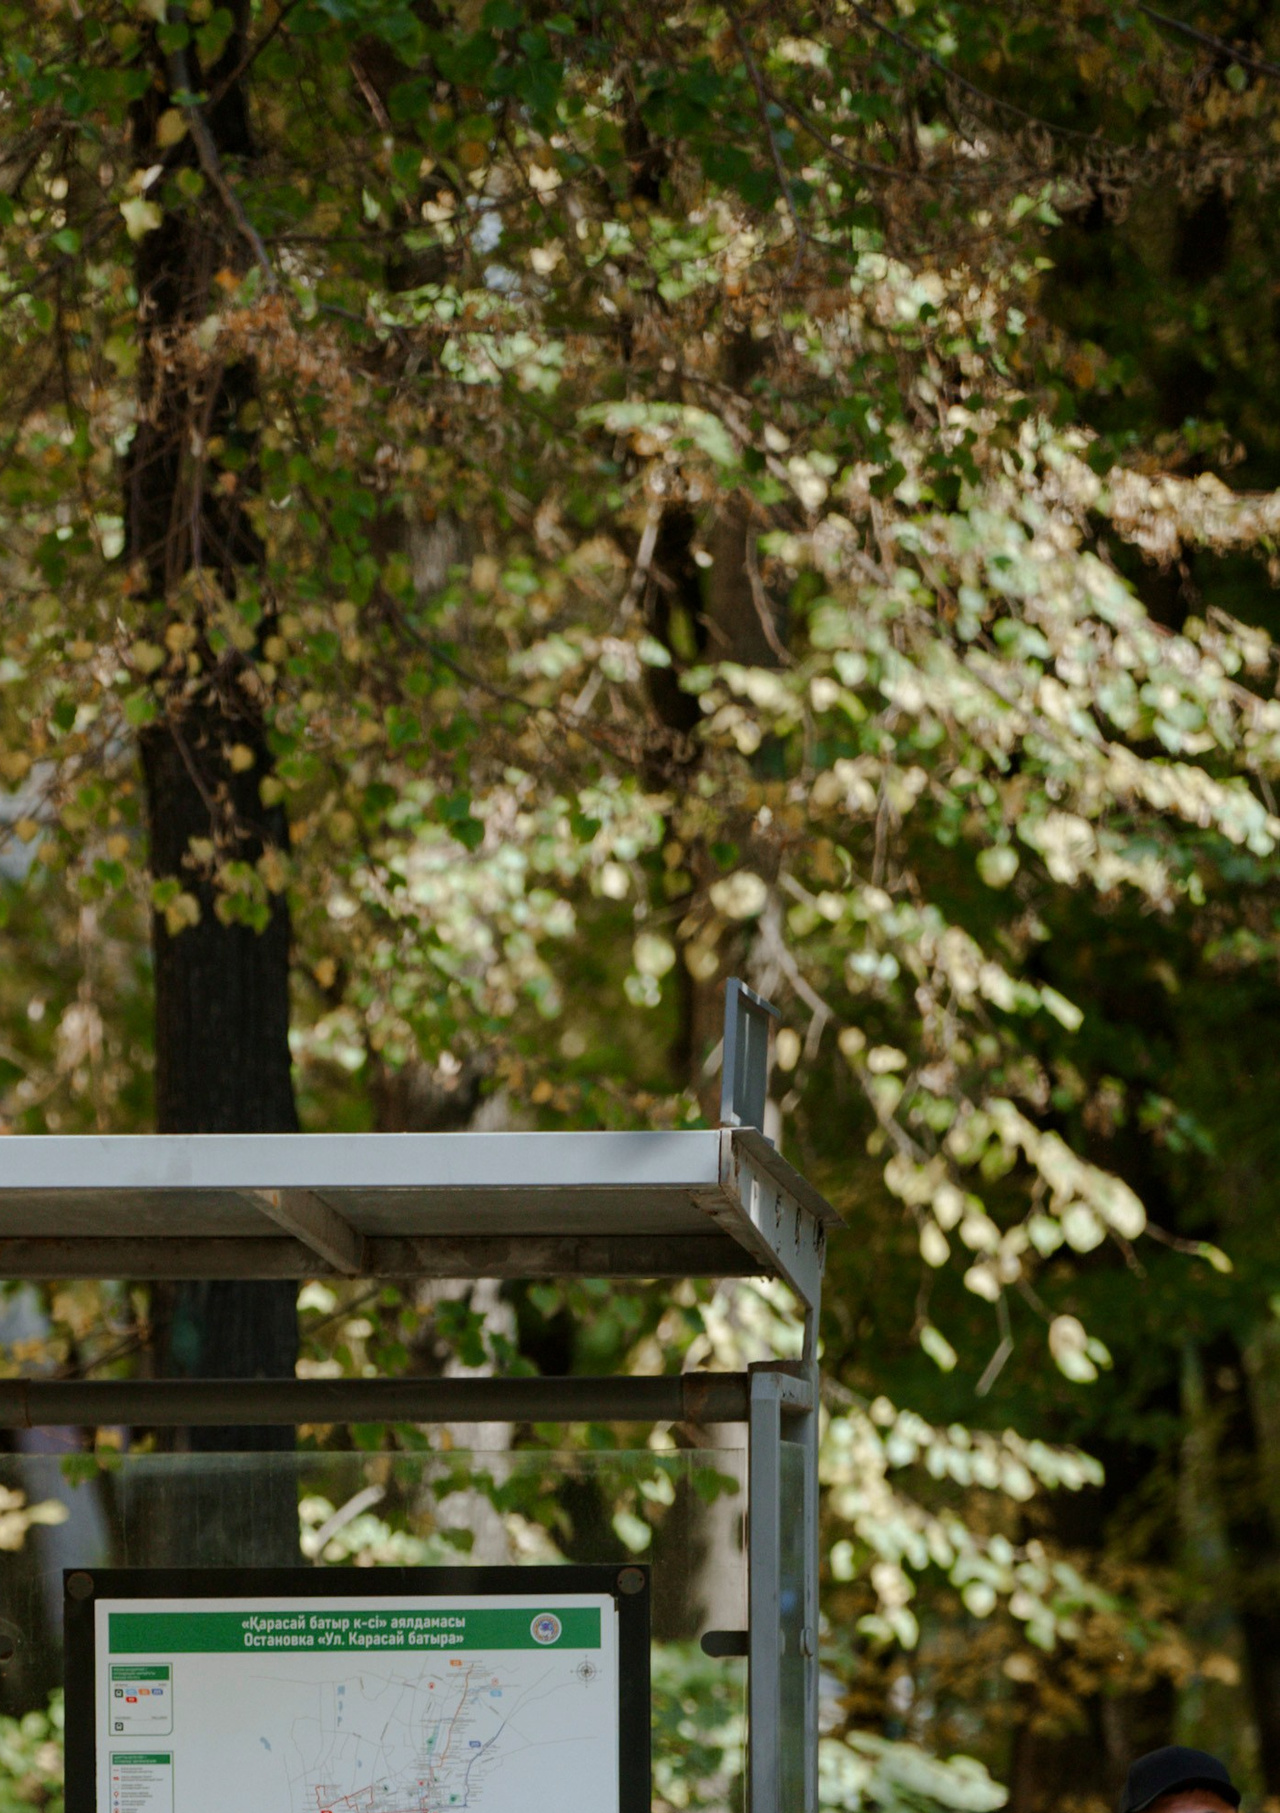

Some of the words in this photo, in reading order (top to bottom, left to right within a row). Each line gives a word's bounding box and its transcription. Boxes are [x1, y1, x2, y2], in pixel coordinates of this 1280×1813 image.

[241, 1615, 306, 1633] «Қарасай
[309, 1615, 351, 1632] батыр
[353, 1614, 387, 1630] к-сі»
[390, 1616, 466, 1630] аялдамасы
[243, 1631, 315, 1647] Остановка
[317, 1631, 345, 1646] «Ул.
[348, 1630, 405, 1648] Карасай
[407, 1630, 465, 1648] батыра»
